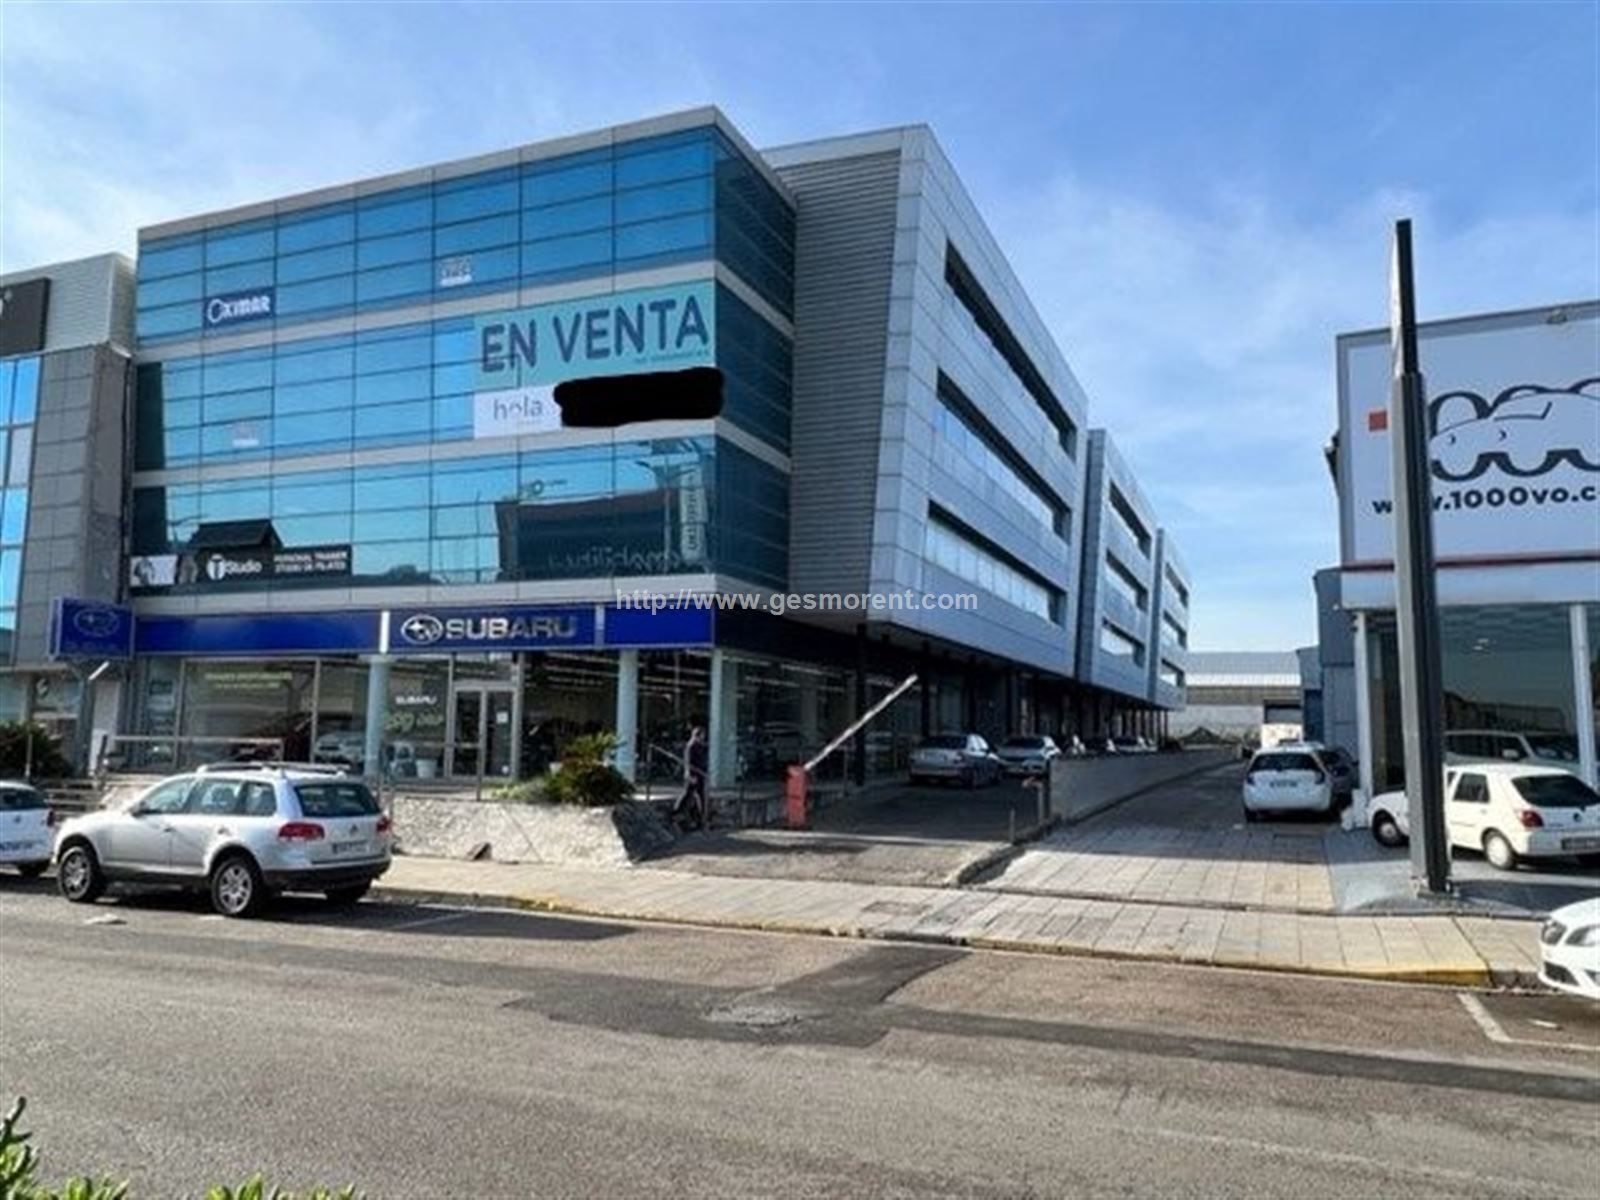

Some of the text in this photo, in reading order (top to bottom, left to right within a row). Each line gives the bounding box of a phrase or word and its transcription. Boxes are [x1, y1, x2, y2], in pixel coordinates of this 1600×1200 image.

[481, 295, 709, 374] EN VENTA
[493, 395, 543, 420] hola
[445, 616, 579, 641] SUBARU
